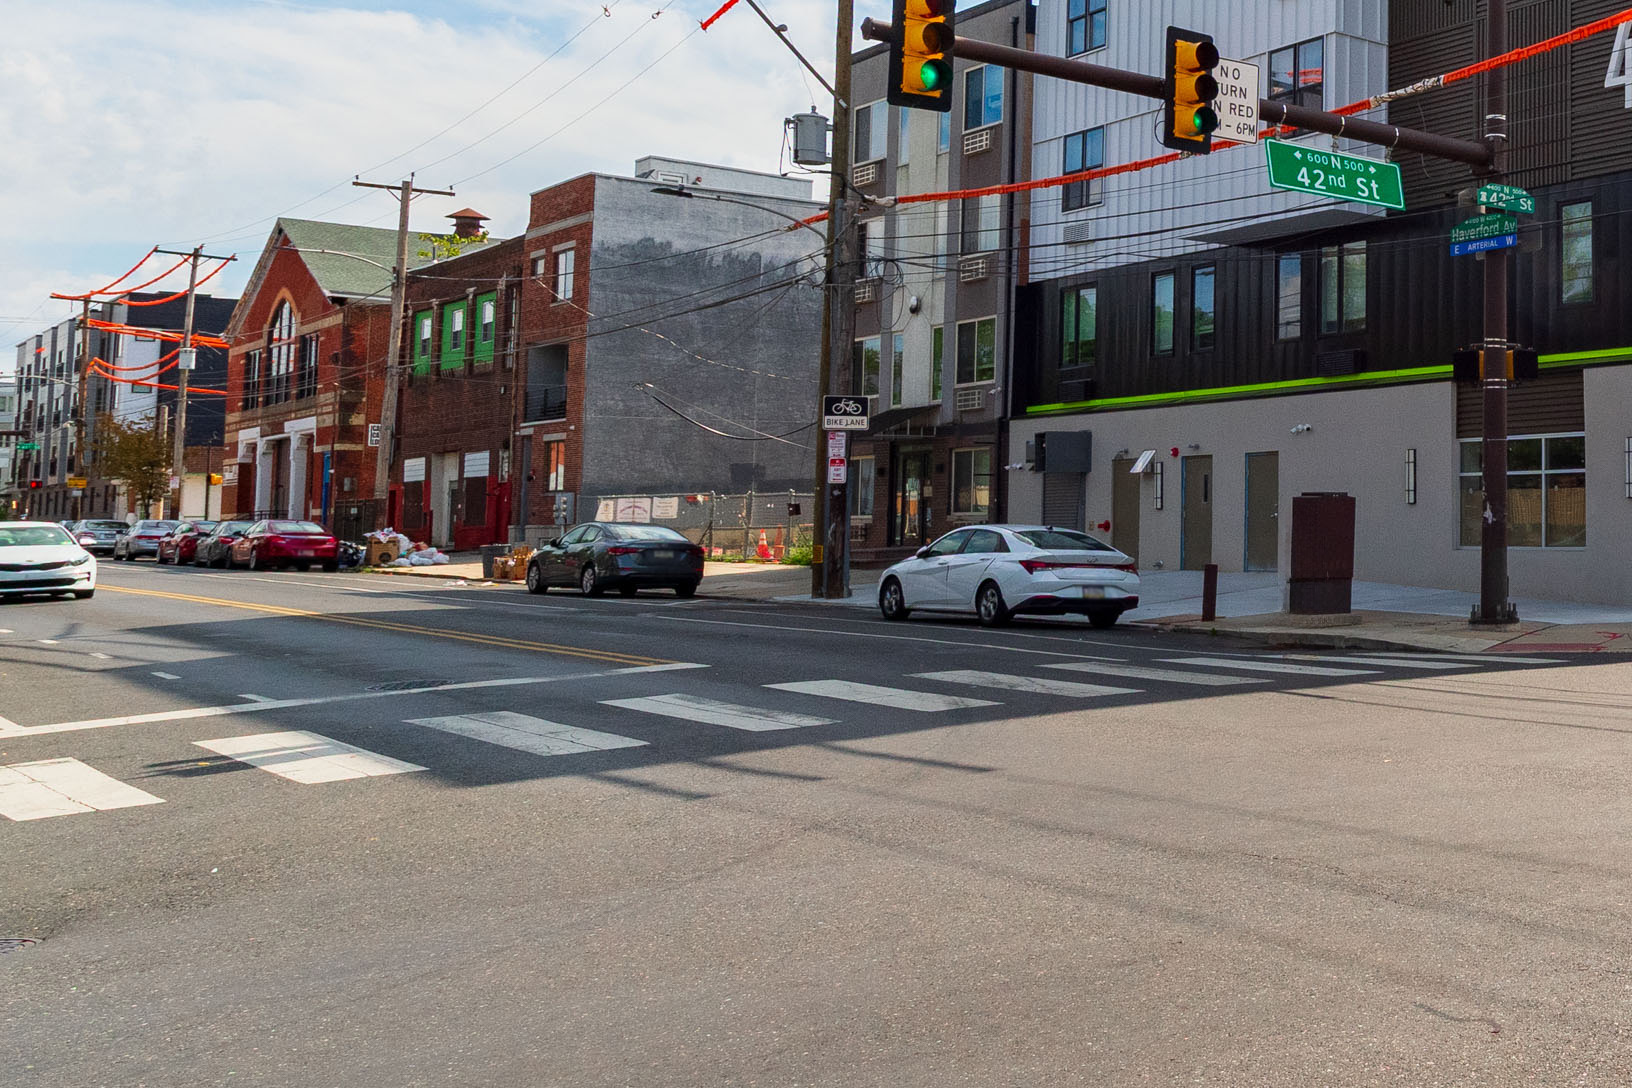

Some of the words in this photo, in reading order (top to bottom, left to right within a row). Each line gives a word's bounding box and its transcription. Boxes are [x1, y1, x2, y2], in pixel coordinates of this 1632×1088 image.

[1220, 65, 1240, 80] NO
[1217, 82, 1247, 99] URN
[1213, 100, 1222, 113] N
[1229, 102, 1254, 118] RED
[1236, 122, 1255, 136] 6PM
[1307, 153, 1328, 165] 600
[1331, 155, 1341, 170] N
[1344, 160, 1364, 172] 500
[1297, 166, 1346, 190] 42nd
[1356, 177, 1380, 200] St
[1504, 186, 1509, 194] N
[1489, 192, 1515, 207] 42nd
[1519, 198, 1532, 211] St
[1452, 221, 1500, 242] Haverford
[1504, 220, 1516, 233] Av
[1454, 245, 1460, 254] E
[1467, 240, 1499, 252] ARTERIAL
[1506, 235, 1514, 246] W
